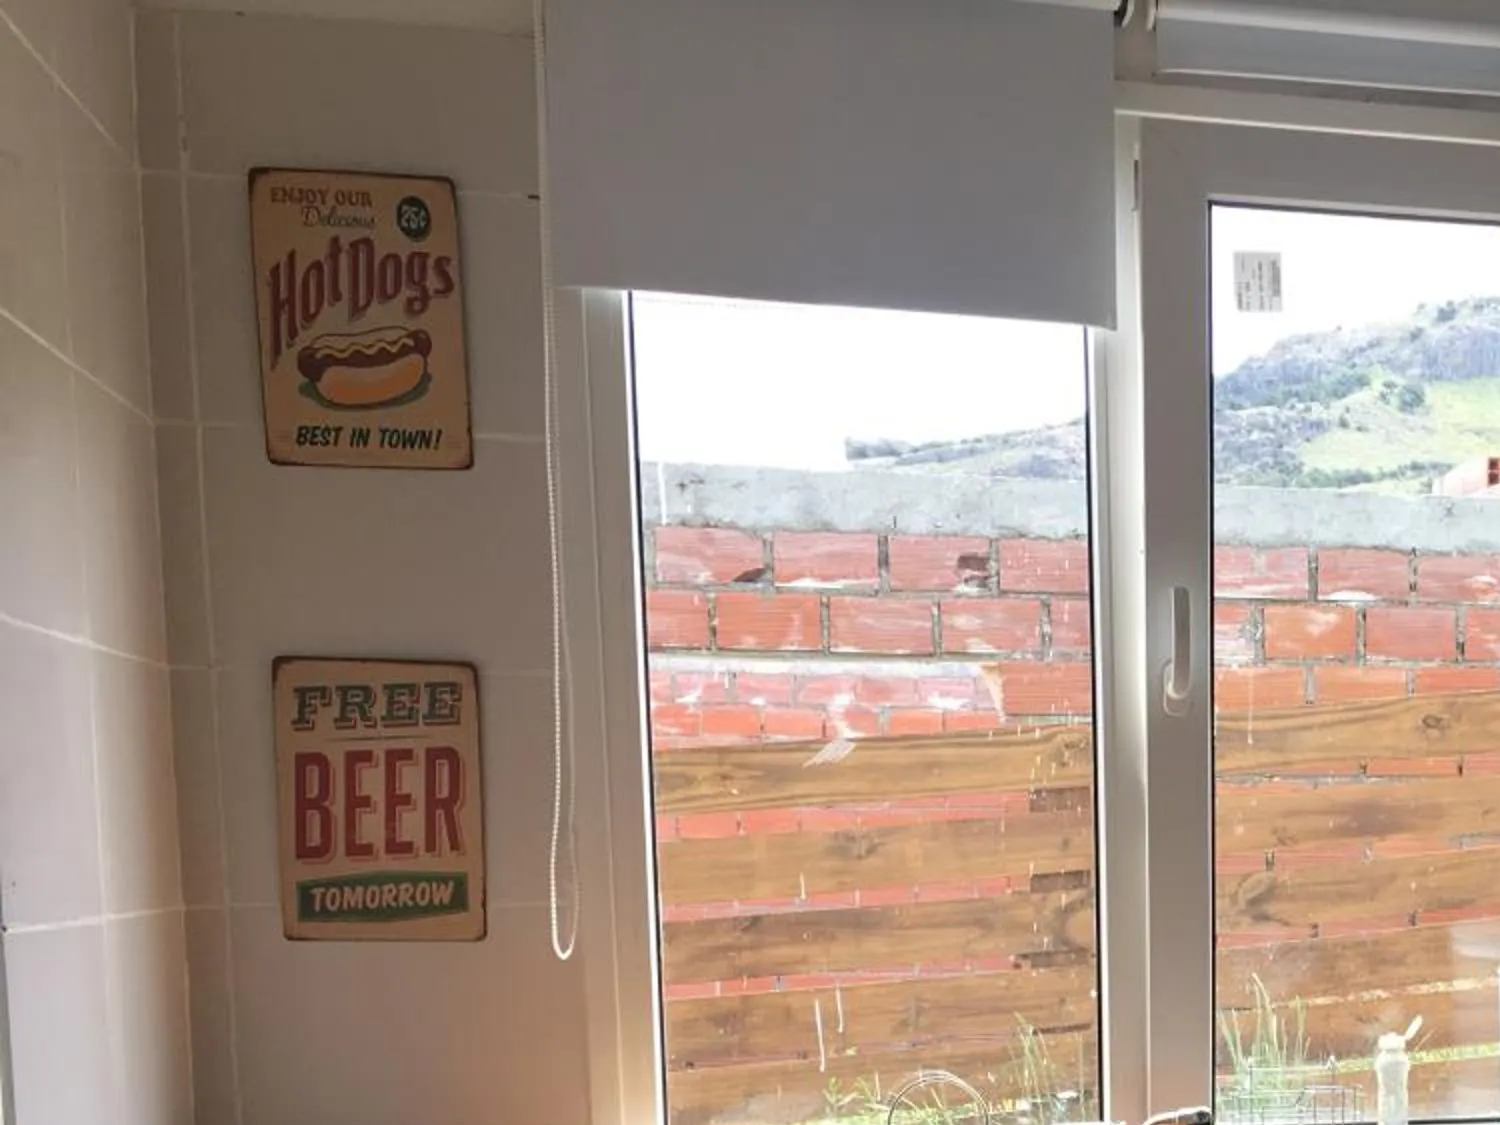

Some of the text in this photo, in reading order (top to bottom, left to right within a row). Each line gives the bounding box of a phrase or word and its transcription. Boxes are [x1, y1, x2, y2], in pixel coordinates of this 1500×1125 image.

[270, 186, 373, 208] ENJOY OUR
[296, 425, 443, 451] BEST IN TOWN!
[291, 681, 463, 731] FREE
[294, 746, 467, 864] BEER
[309, 881, 455, 912] TOMORROW
